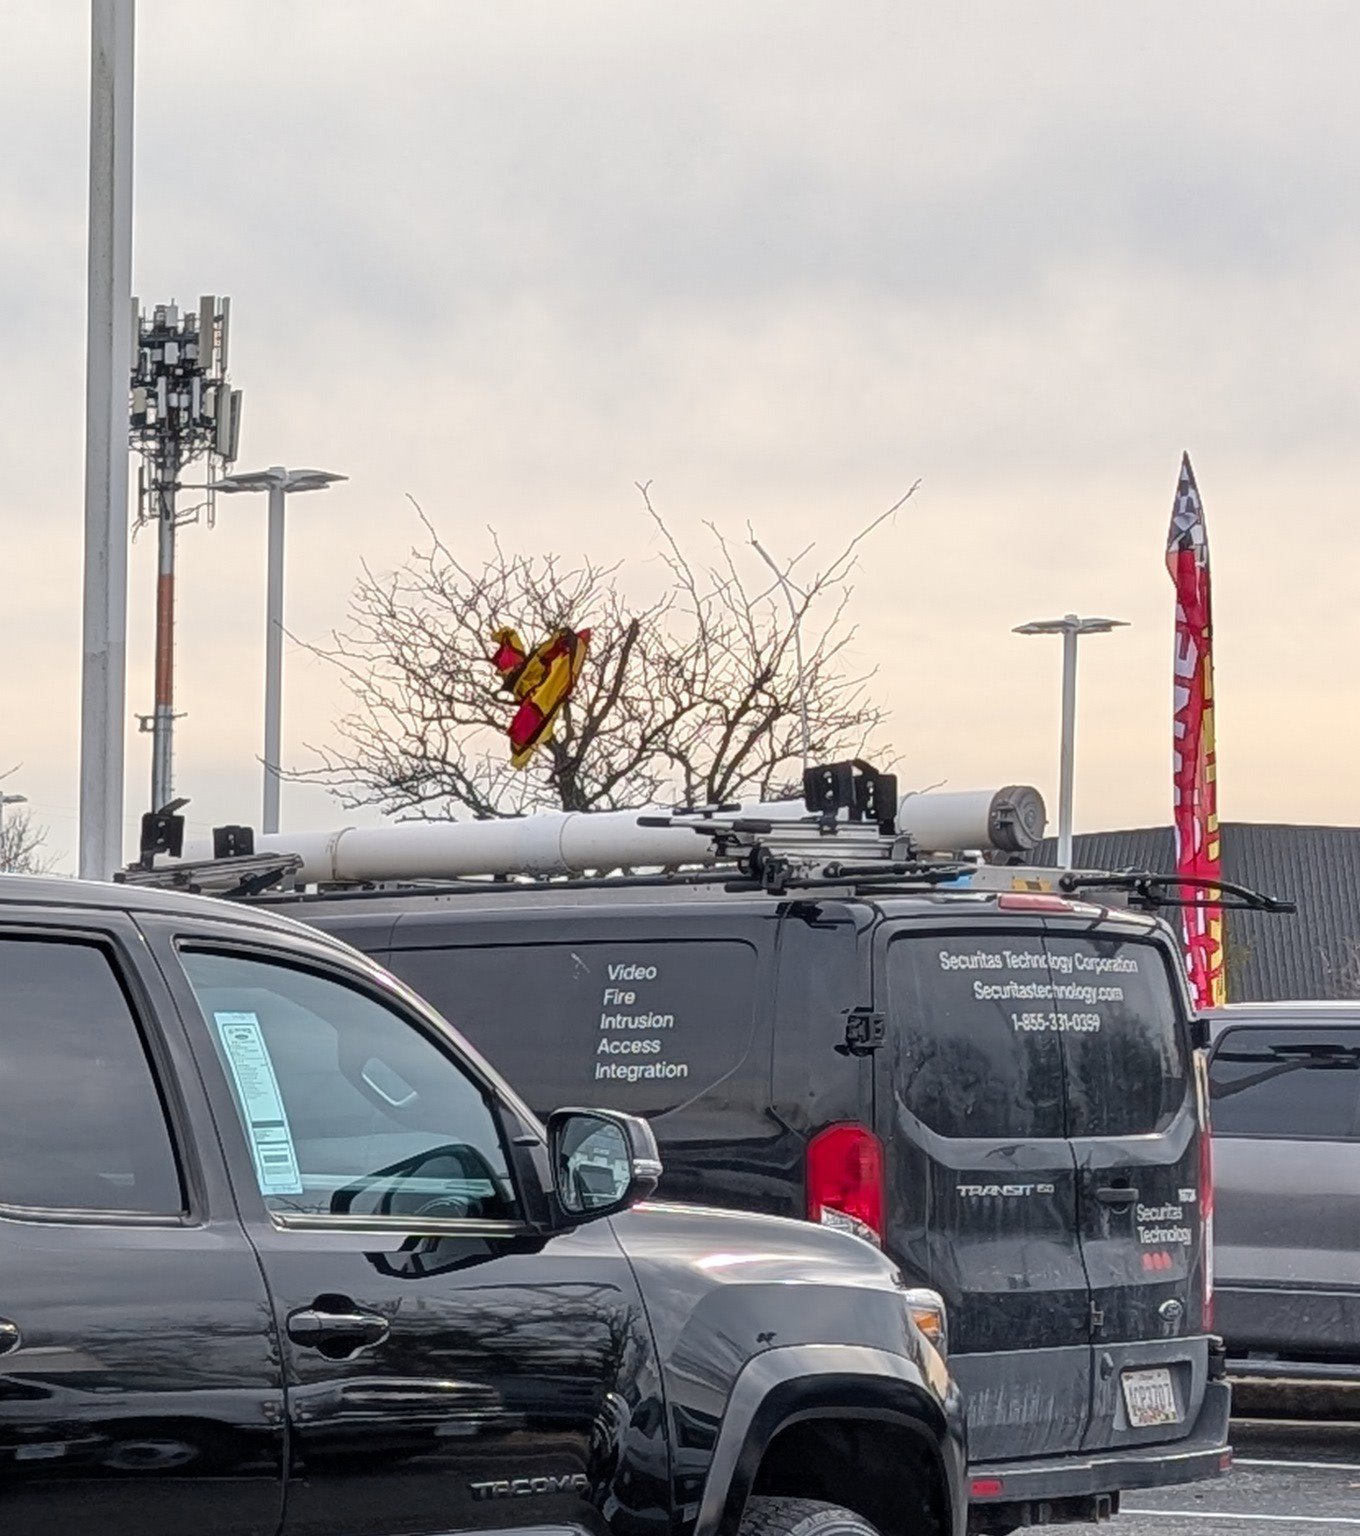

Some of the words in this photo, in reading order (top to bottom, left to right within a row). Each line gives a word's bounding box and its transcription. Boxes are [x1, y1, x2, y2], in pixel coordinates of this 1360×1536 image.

[607, 963, 658, 981] Video
[938, 950, 1003, 971] Securitas
[1003, 951, 1073, 974] Technology
[1074, 953, 1139, 975] Corporation
[603, 987, 636, 1006] Fire
[972, 980, 1124, 1004] Securitastechnology.com
[600, 1011, 675, 1029] Intrusion
[596, 1037, 662, 1055] Access
[594, 1060, 689, 1082] Integration
[956, 1184, 1035, 1197] TRANSIT
[1136, 1202, 1183, 1223] Securitas
[1137, 1225, 1193, 1246] Technology
[467, 1472, 594, 1500] TACOMA
